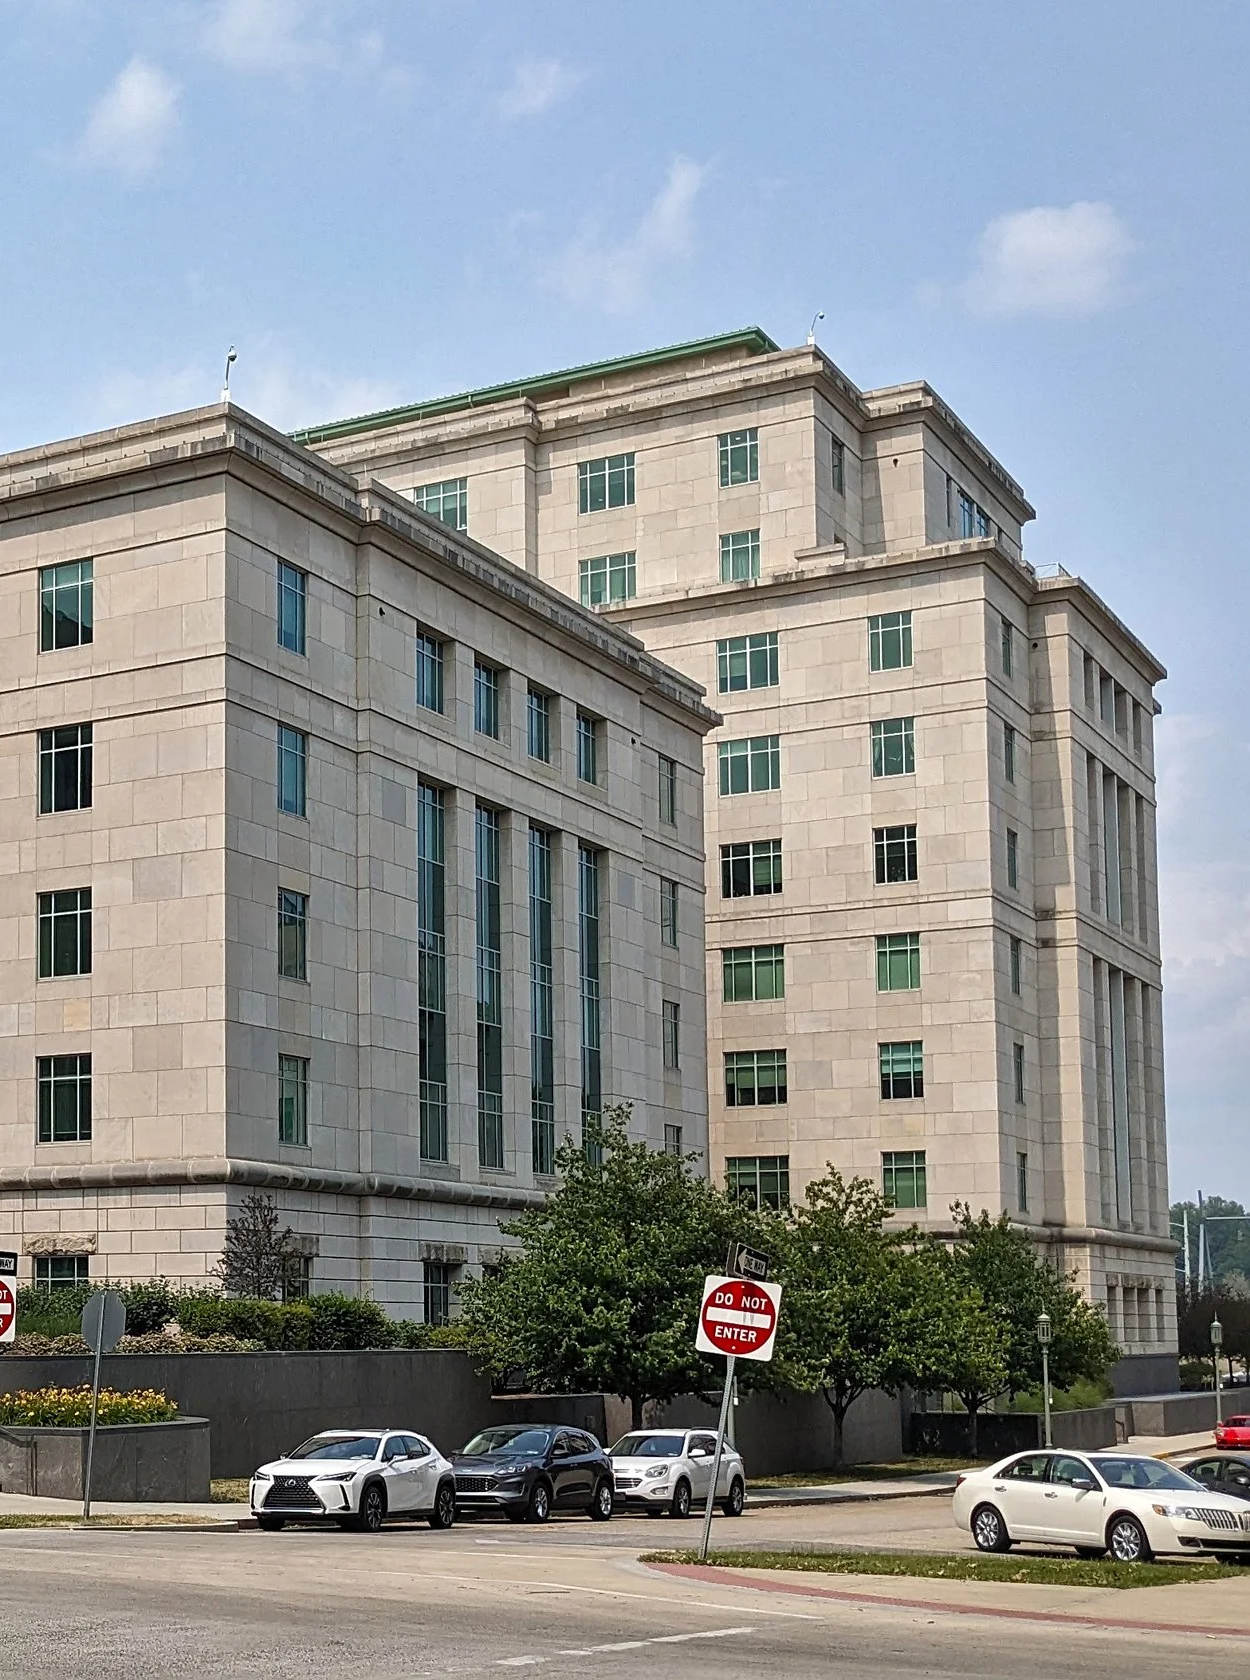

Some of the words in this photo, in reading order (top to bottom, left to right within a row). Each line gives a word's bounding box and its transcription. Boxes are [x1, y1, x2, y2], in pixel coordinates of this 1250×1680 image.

[0, 1258, 13, 1269] WAY
[715, 1292, 734, 1306] DO
[741, 1295, 768, 1310] NOT
[715, 1325, 757, 1343] ENTER
